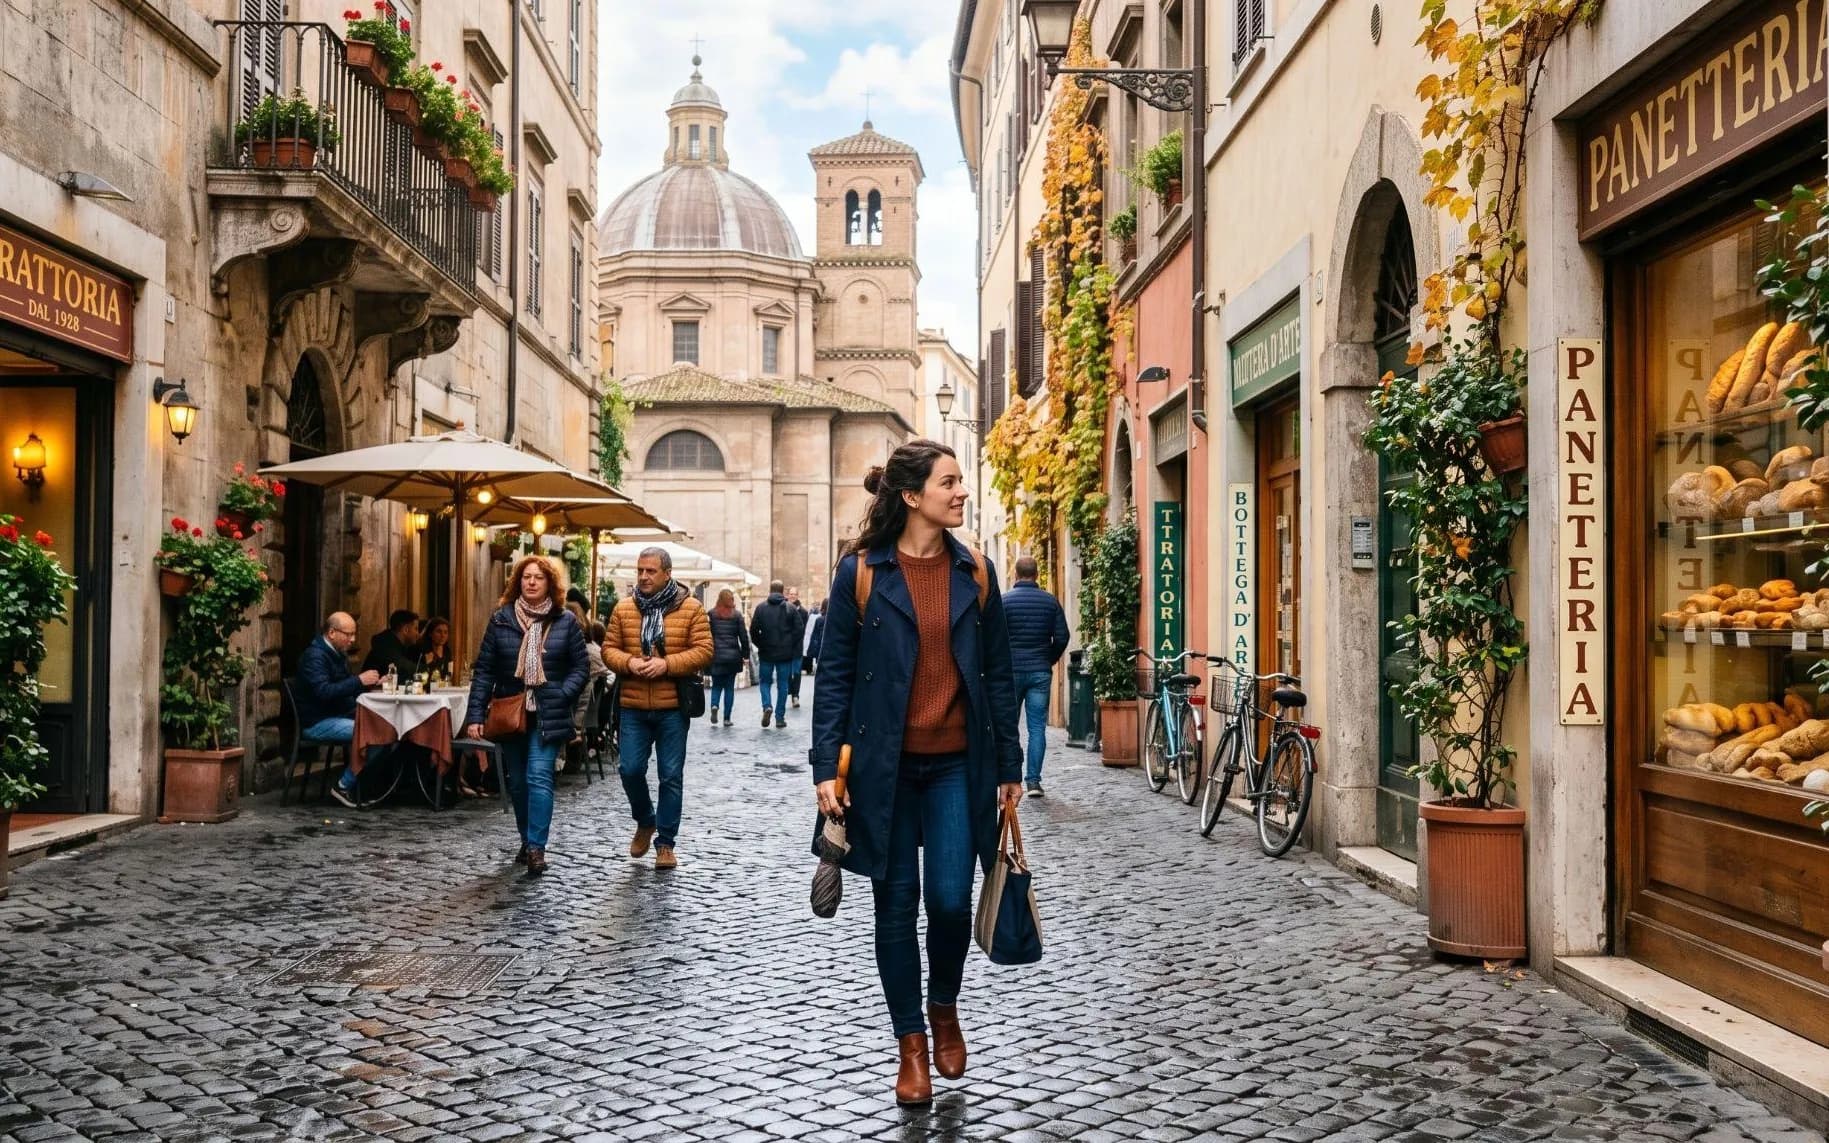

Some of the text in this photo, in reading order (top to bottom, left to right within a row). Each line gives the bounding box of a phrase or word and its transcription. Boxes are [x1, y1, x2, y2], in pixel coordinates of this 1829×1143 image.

[28, 299, 80, 332] DAL 1928
[1160, 509, 1175, 651] TTRATORIA
[1234, 491, 1248, 605] BOTTEGA
[1565, 347, 1598, 716] PANETERIA
